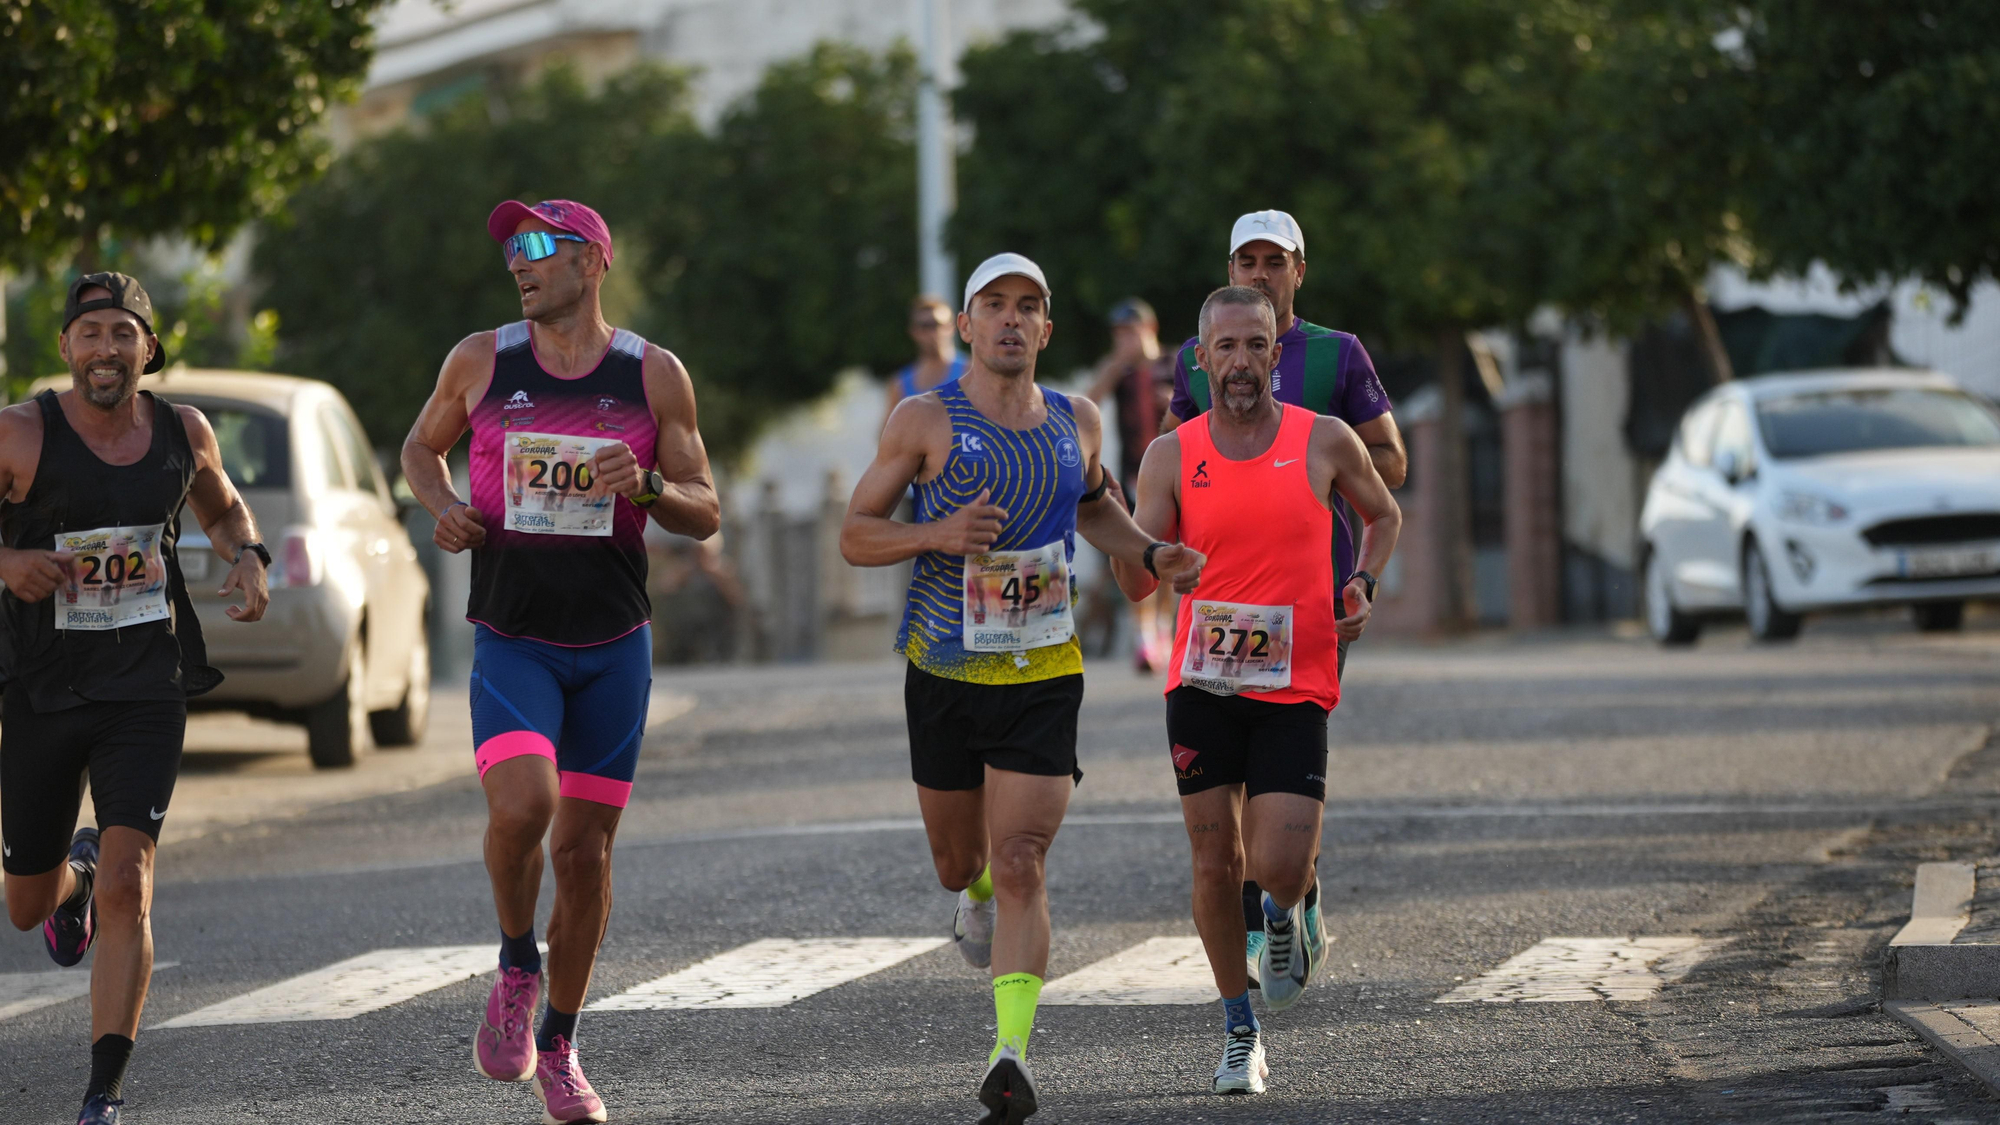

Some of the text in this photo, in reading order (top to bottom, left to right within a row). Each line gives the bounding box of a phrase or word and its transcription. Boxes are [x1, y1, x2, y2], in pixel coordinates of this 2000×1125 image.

[528, 459, 594, 492] 200
[1190, 480, 1211, 488] Talai
[82, 551, 146, 585] 202
[1001, 574, 1040, 606] 45
[67, 615, 114, 624] populares
[974, 637, 1021, 646] populares
[1209, 627, 1269, 657] 272
[1175, 766, 1203, 779] TALAI
[1306, 773, 1326, 783] JOM
